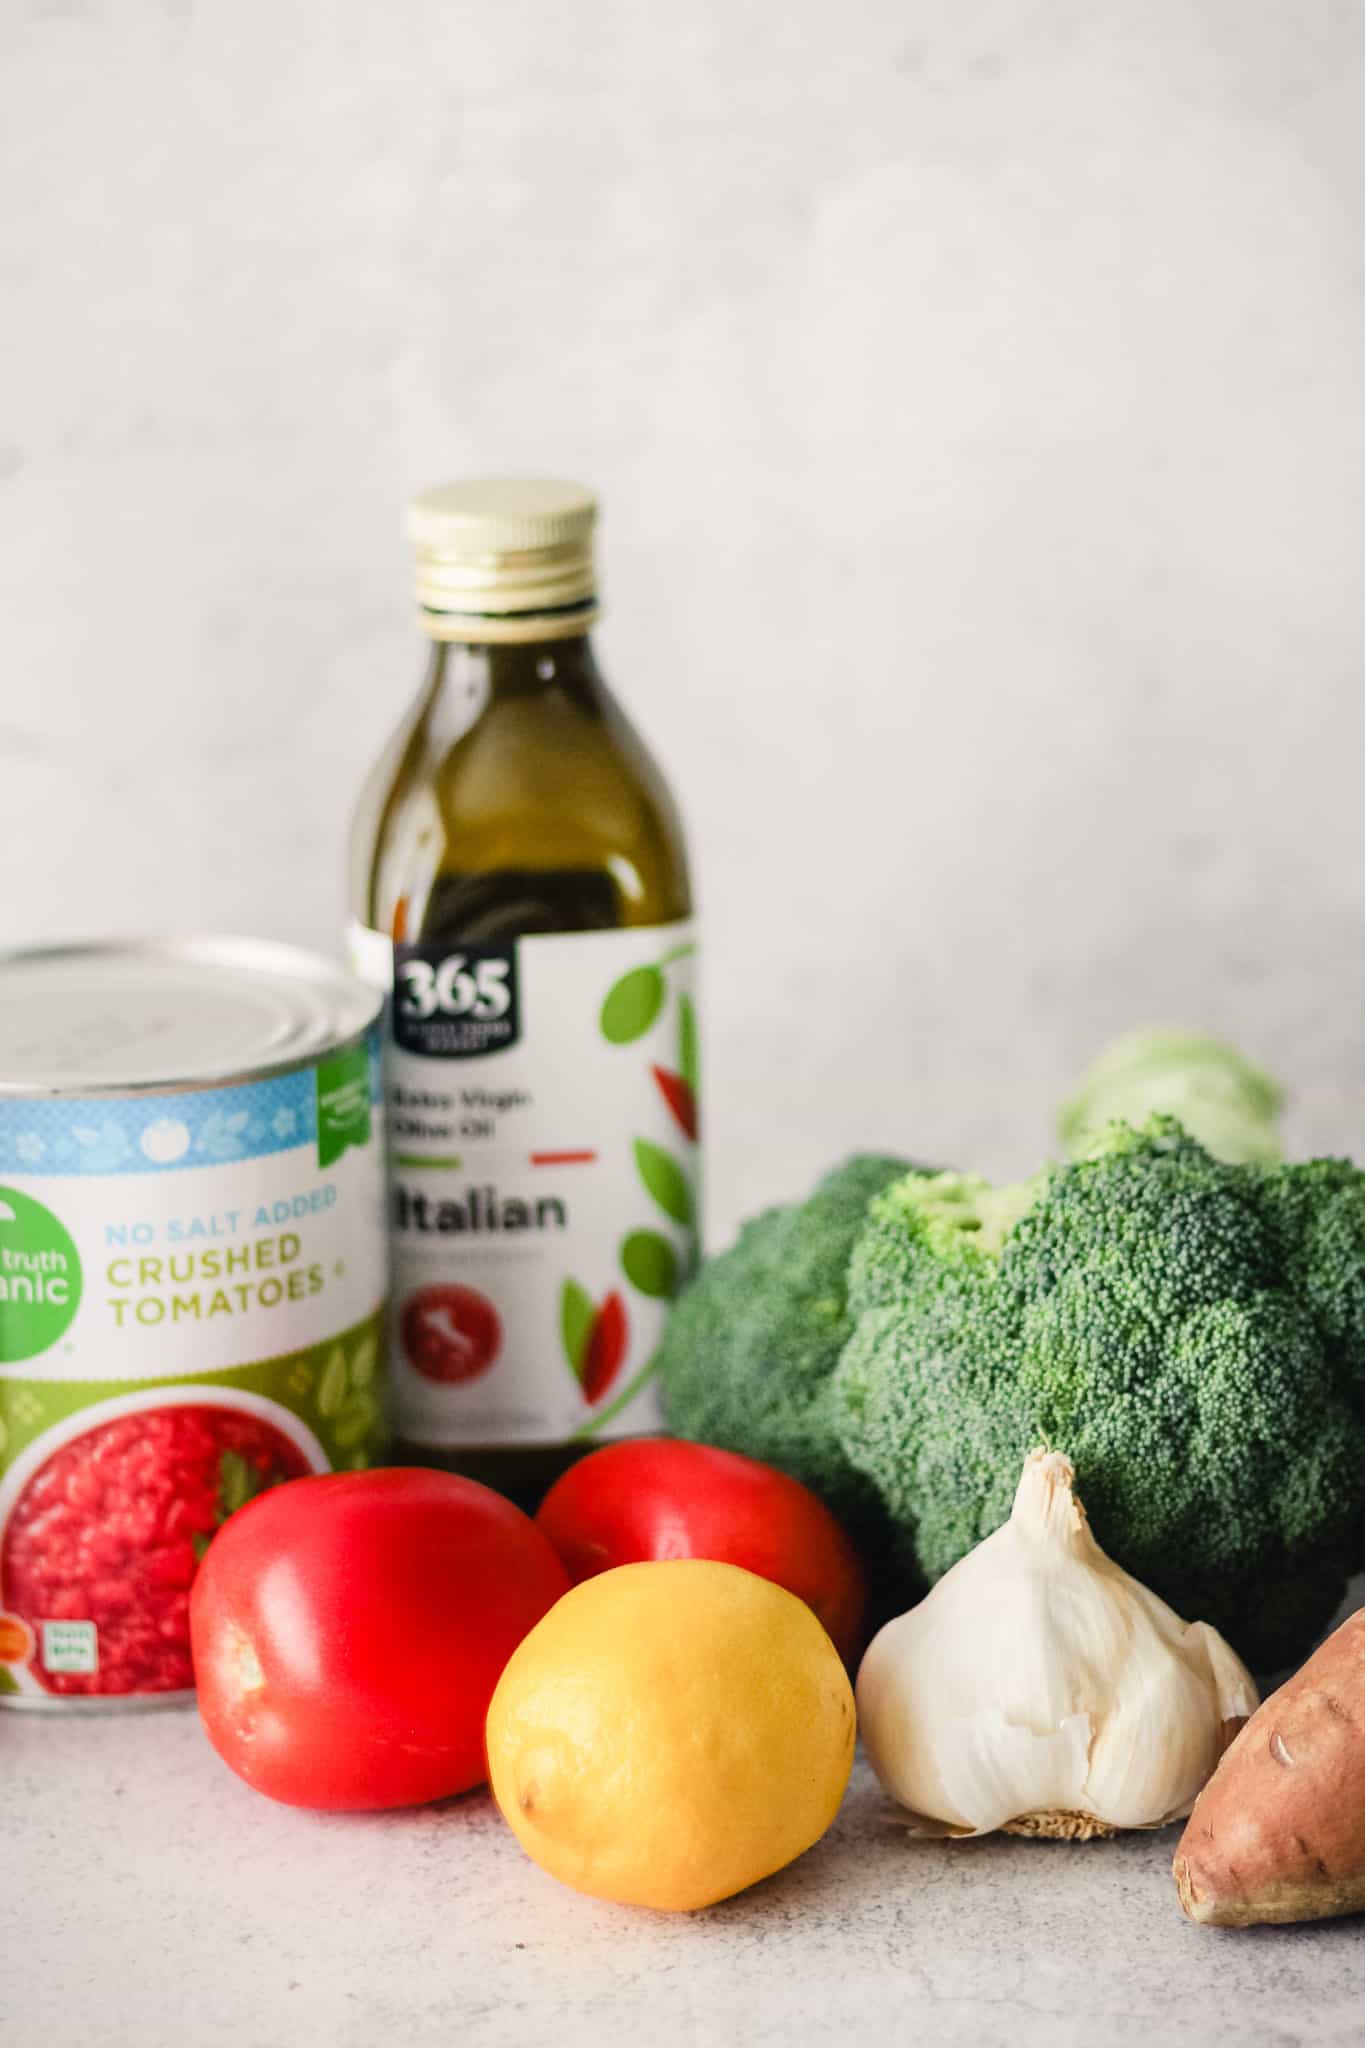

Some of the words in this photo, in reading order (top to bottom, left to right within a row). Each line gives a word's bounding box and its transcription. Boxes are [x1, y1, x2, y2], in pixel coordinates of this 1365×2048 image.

[399, 954, 511, 1020] 365
[105, 1222, 154, 1247] NO
[167, 1210, 240, 1243] SALT
[254, 1184, 337, 1228] ADDED
[394, 1184, 566, 1234] Italian
[3, 1248, 68, 1272] truth
[106, 1233, 302, 1288] CRUSHED
[106, 1263, 324, 1327] TOMATOES
